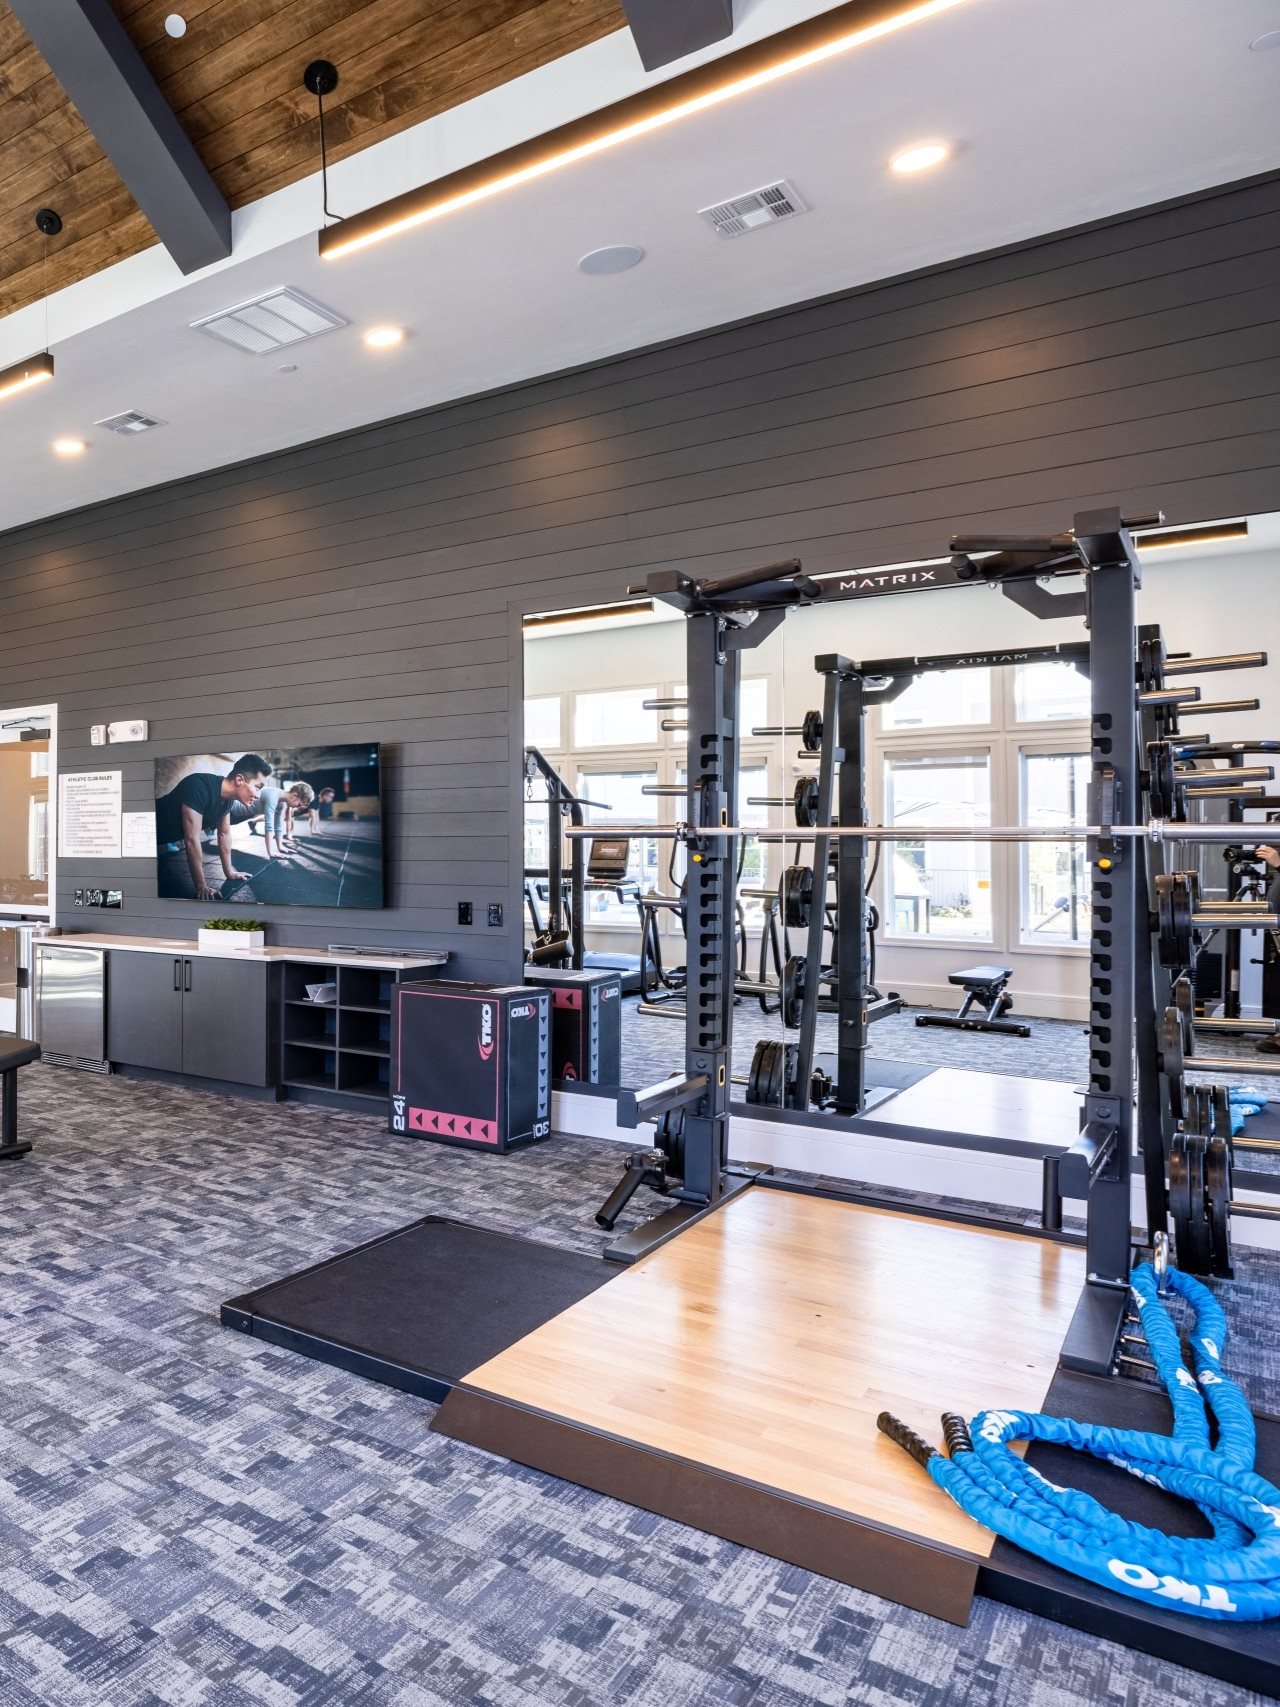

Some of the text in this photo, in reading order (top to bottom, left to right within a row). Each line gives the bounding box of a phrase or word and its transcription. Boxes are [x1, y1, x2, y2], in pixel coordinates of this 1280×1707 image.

[840, 570, 936, 591] MATRIX
[482, 1004, 492, 1046] TKO
[510, 1006, 530, 1018] TKO
[393, 1100, 405, 1131] 24
[535, 1120, 550, 1137] 30
[1107, 1558, 1238, 1613] TKO
